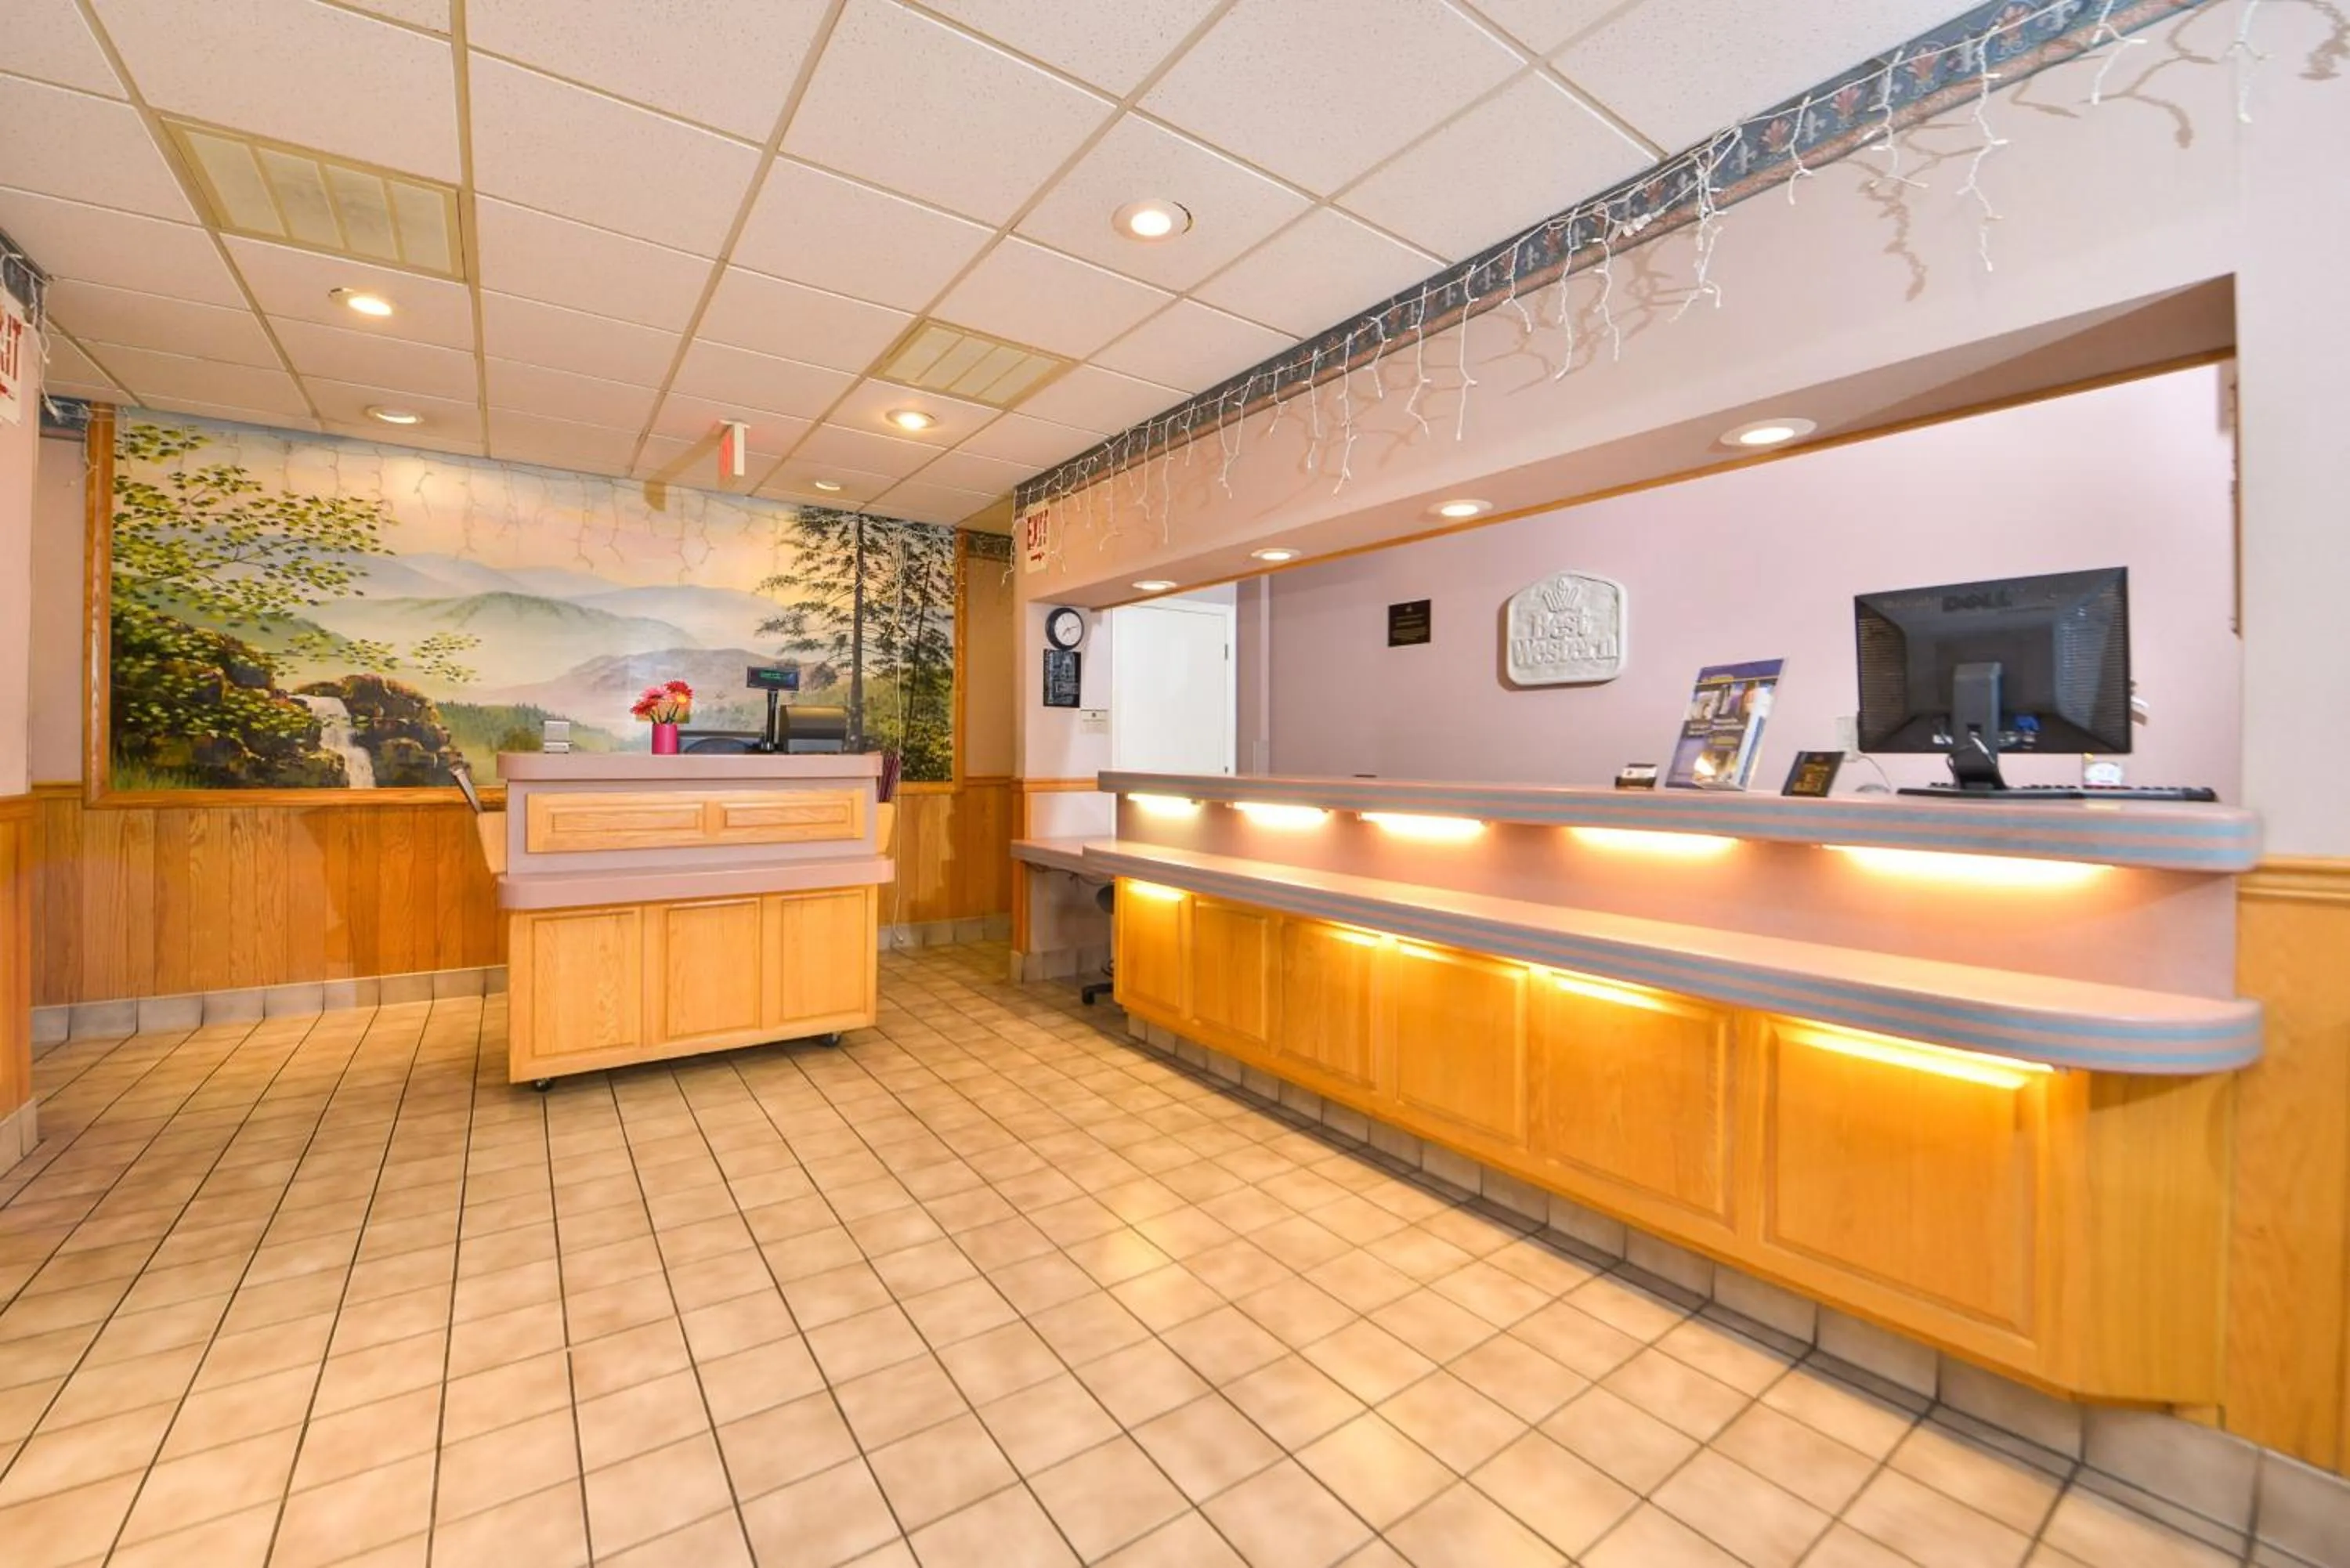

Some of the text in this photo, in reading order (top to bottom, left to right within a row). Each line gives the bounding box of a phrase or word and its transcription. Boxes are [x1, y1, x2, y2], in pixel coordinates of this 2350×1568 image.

[1027, 508, 1049, 551] EXIT
[1942, 589, 2012, 612] DELL
[1530, 608, 1591, 641] Best
[1512, 636, 1618, 668] Western
